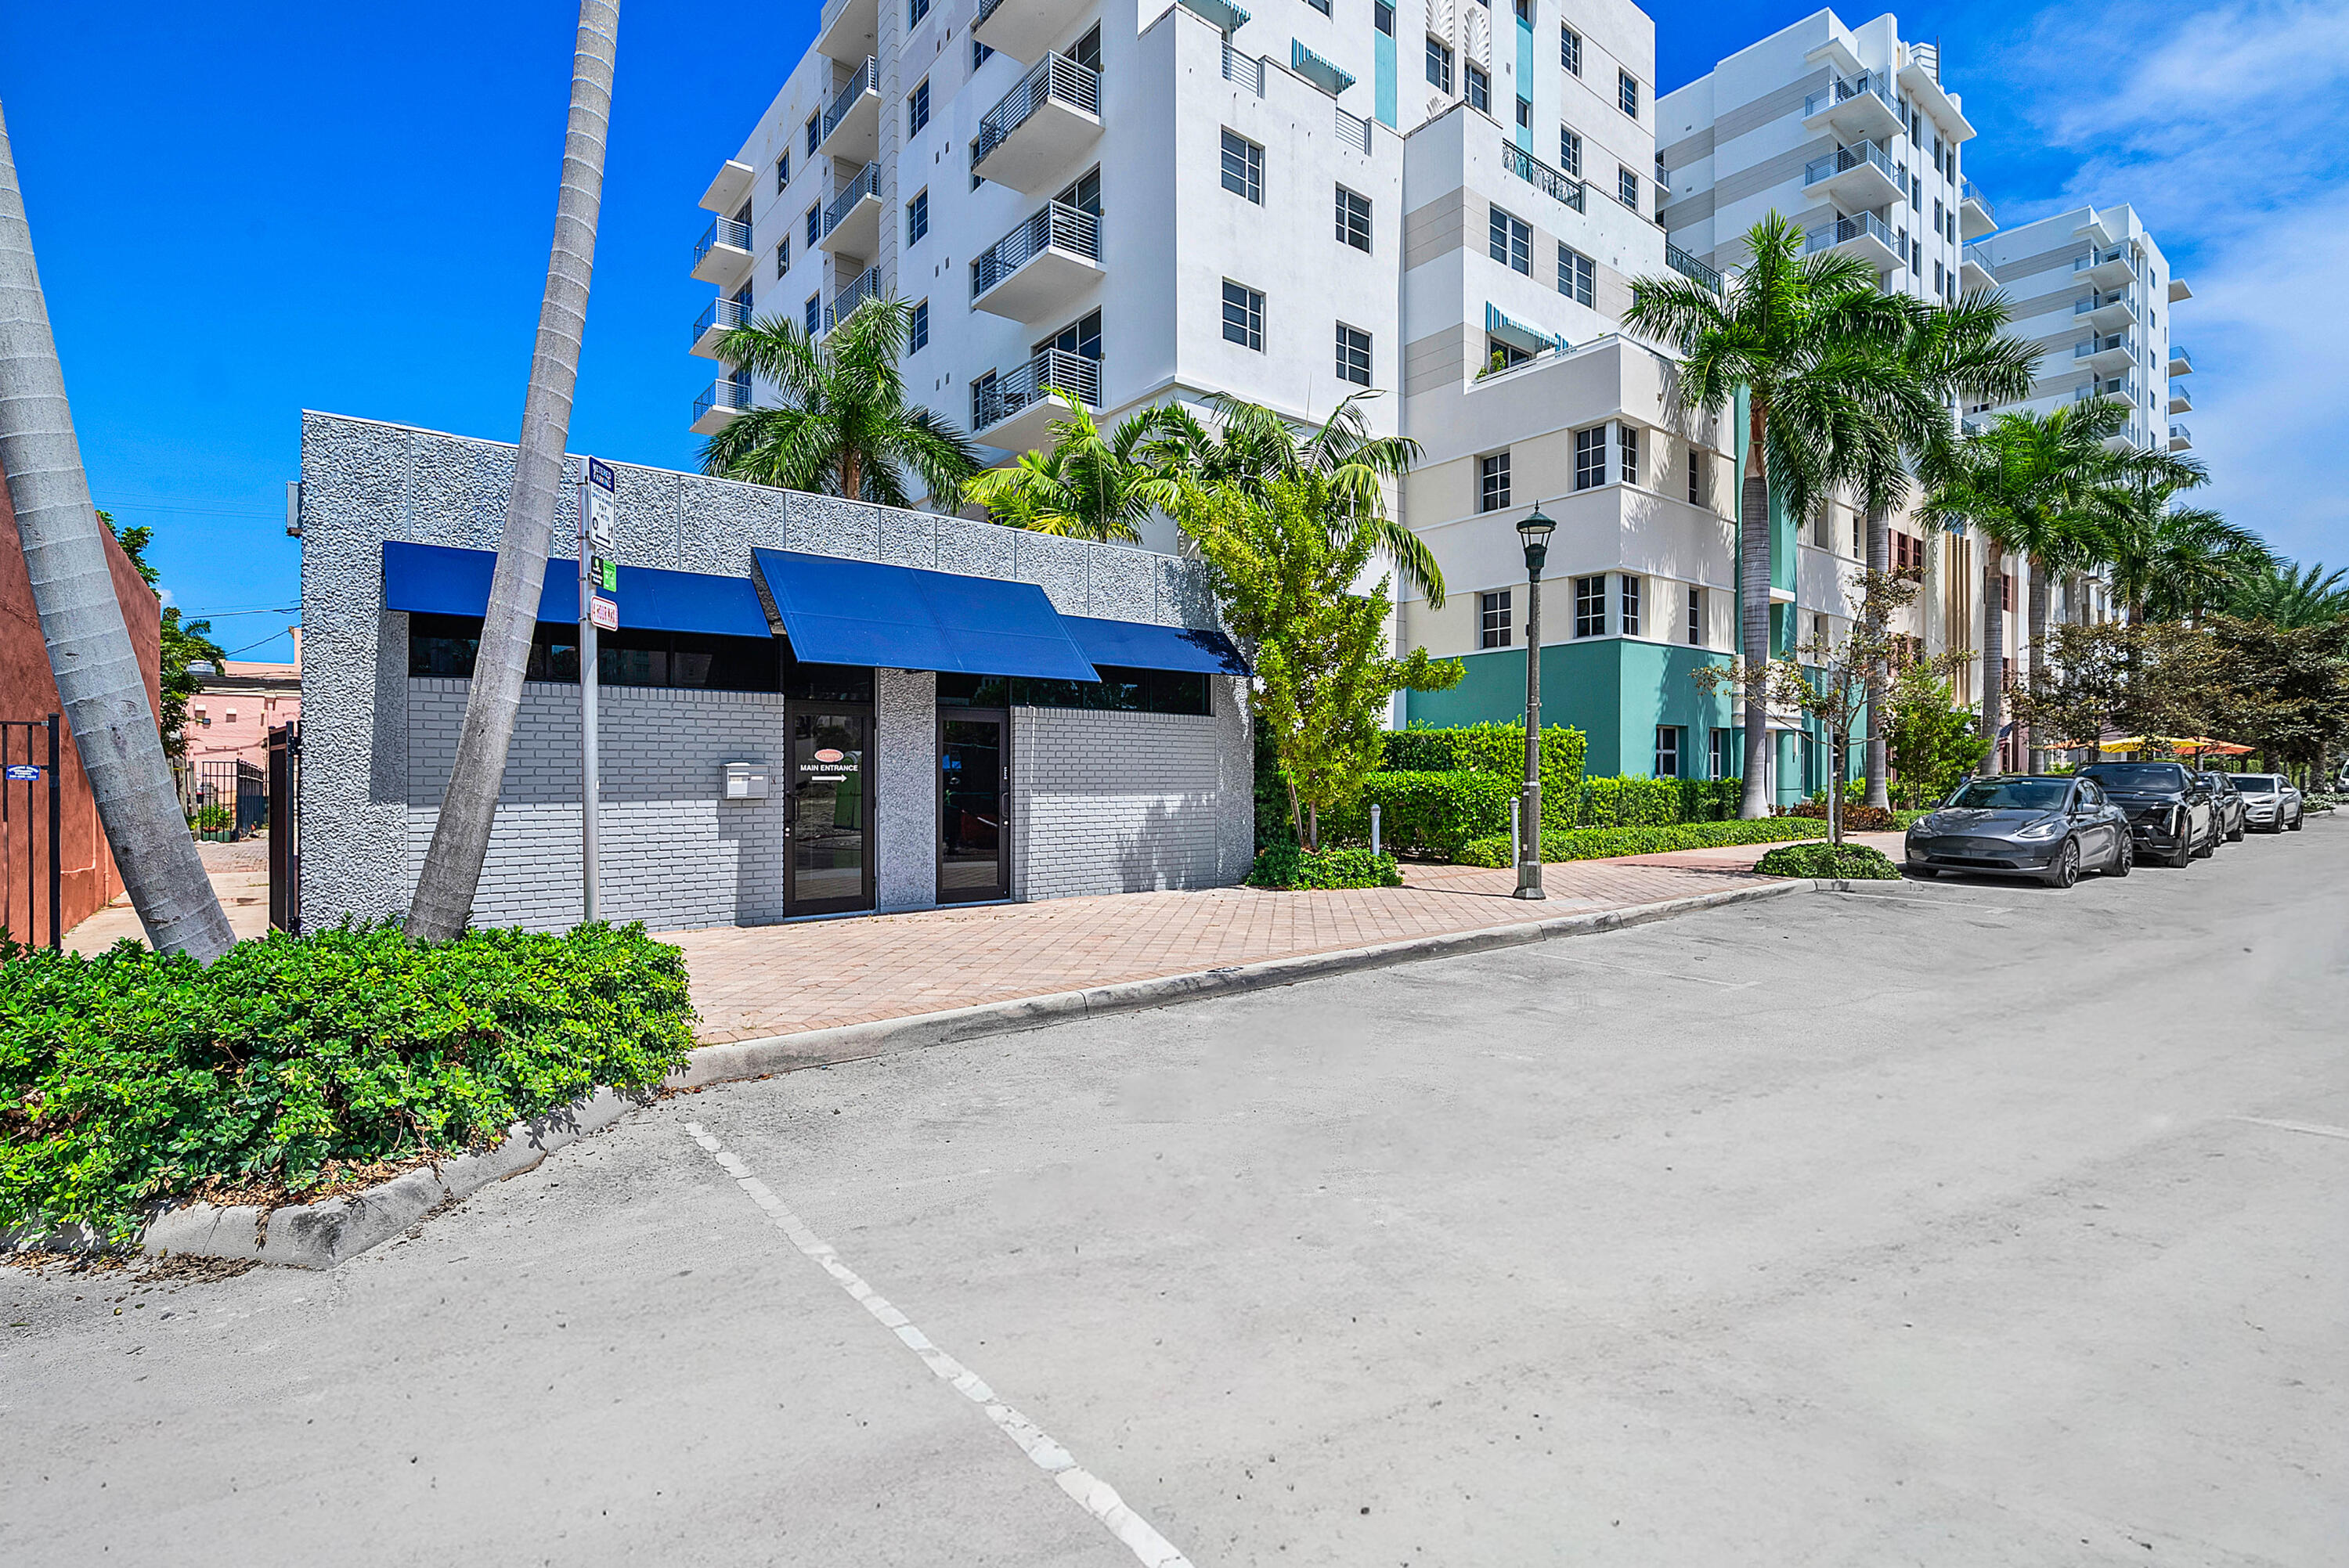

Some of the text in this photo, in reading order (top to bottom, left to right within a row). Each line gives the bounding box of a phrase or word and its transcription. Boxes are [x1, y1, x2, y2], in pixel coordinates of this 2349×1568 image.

[593, 463, 612, 478] METERED
[593, 470, 612, 488] PARKING
[593, 485, 603, 496] CHECK
[598, 503, 607, 514] PAY
[597, 604, 607, 621] HOUR
